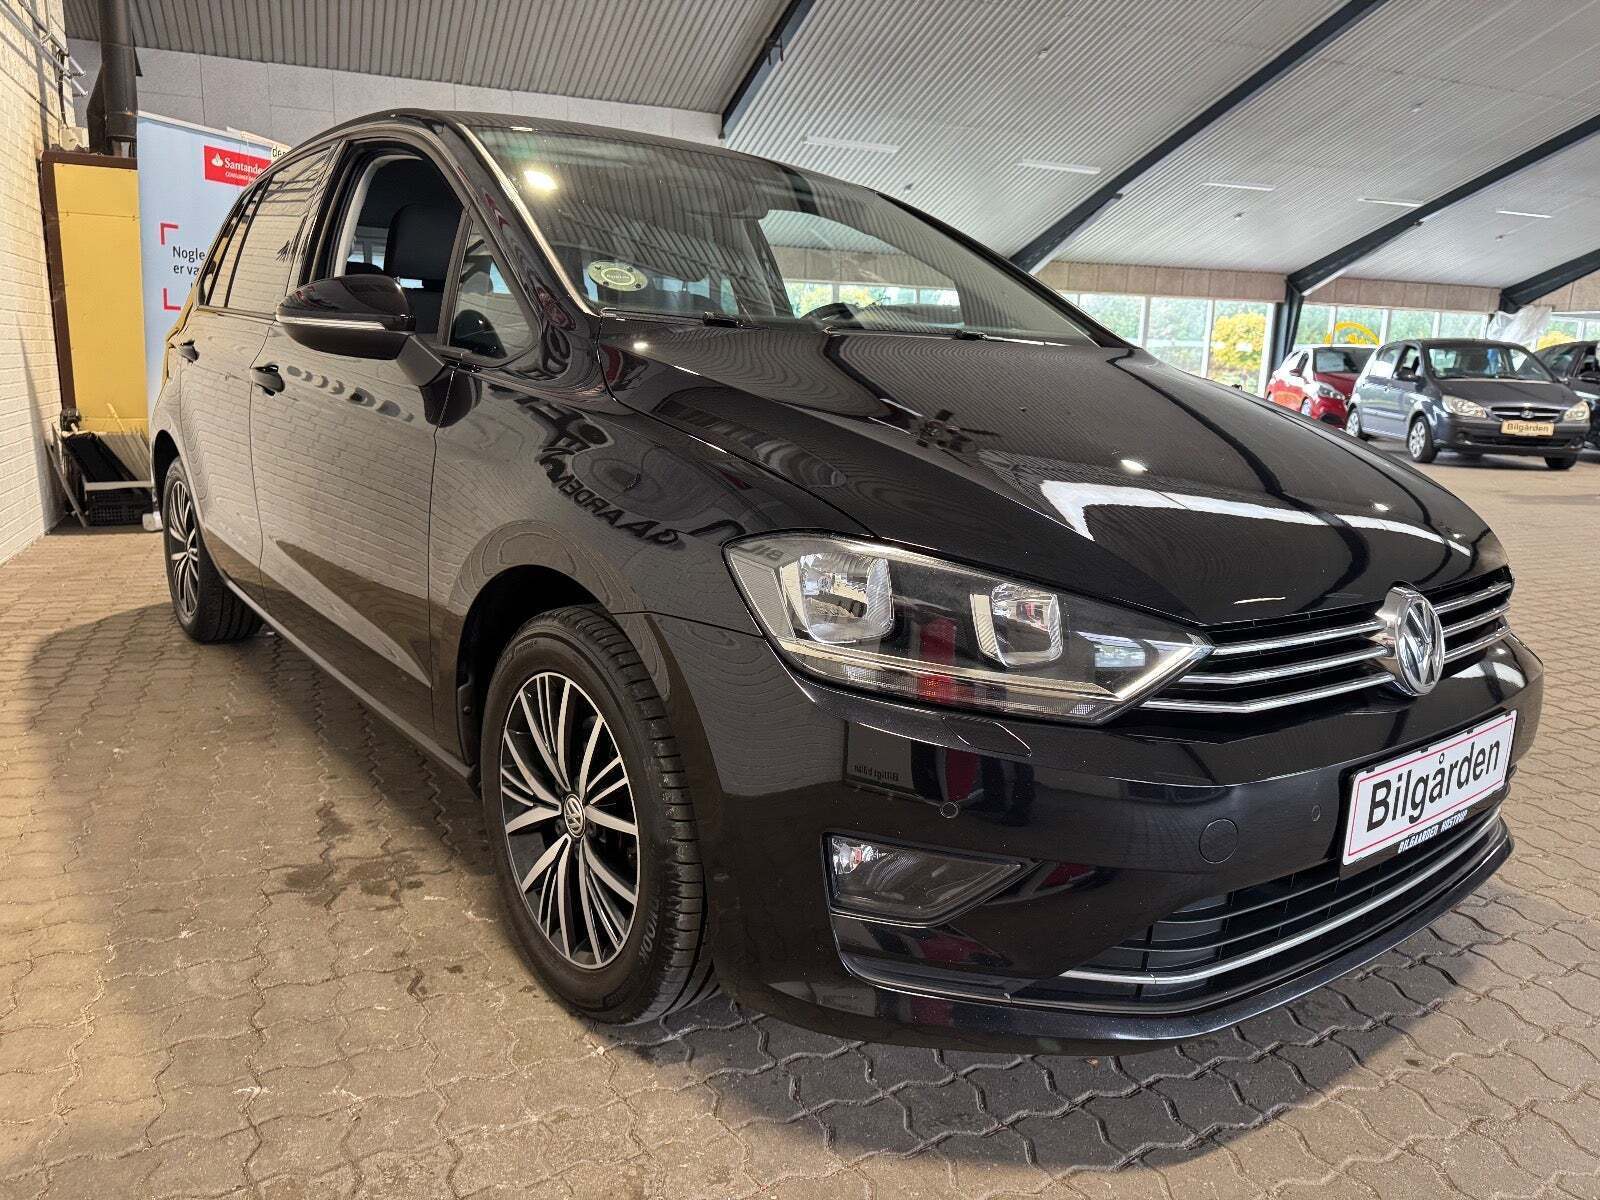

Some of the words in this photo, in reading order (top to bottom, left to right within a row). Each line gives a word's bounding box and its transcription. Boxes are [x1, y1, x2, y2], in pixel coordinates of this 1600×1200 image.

[224, 157, 266, 175] Santande
[172, 245, 206, 263] Nogle
[173, 264, 184, 274] er
[1366, 738, 1501, 834] Bilgården
